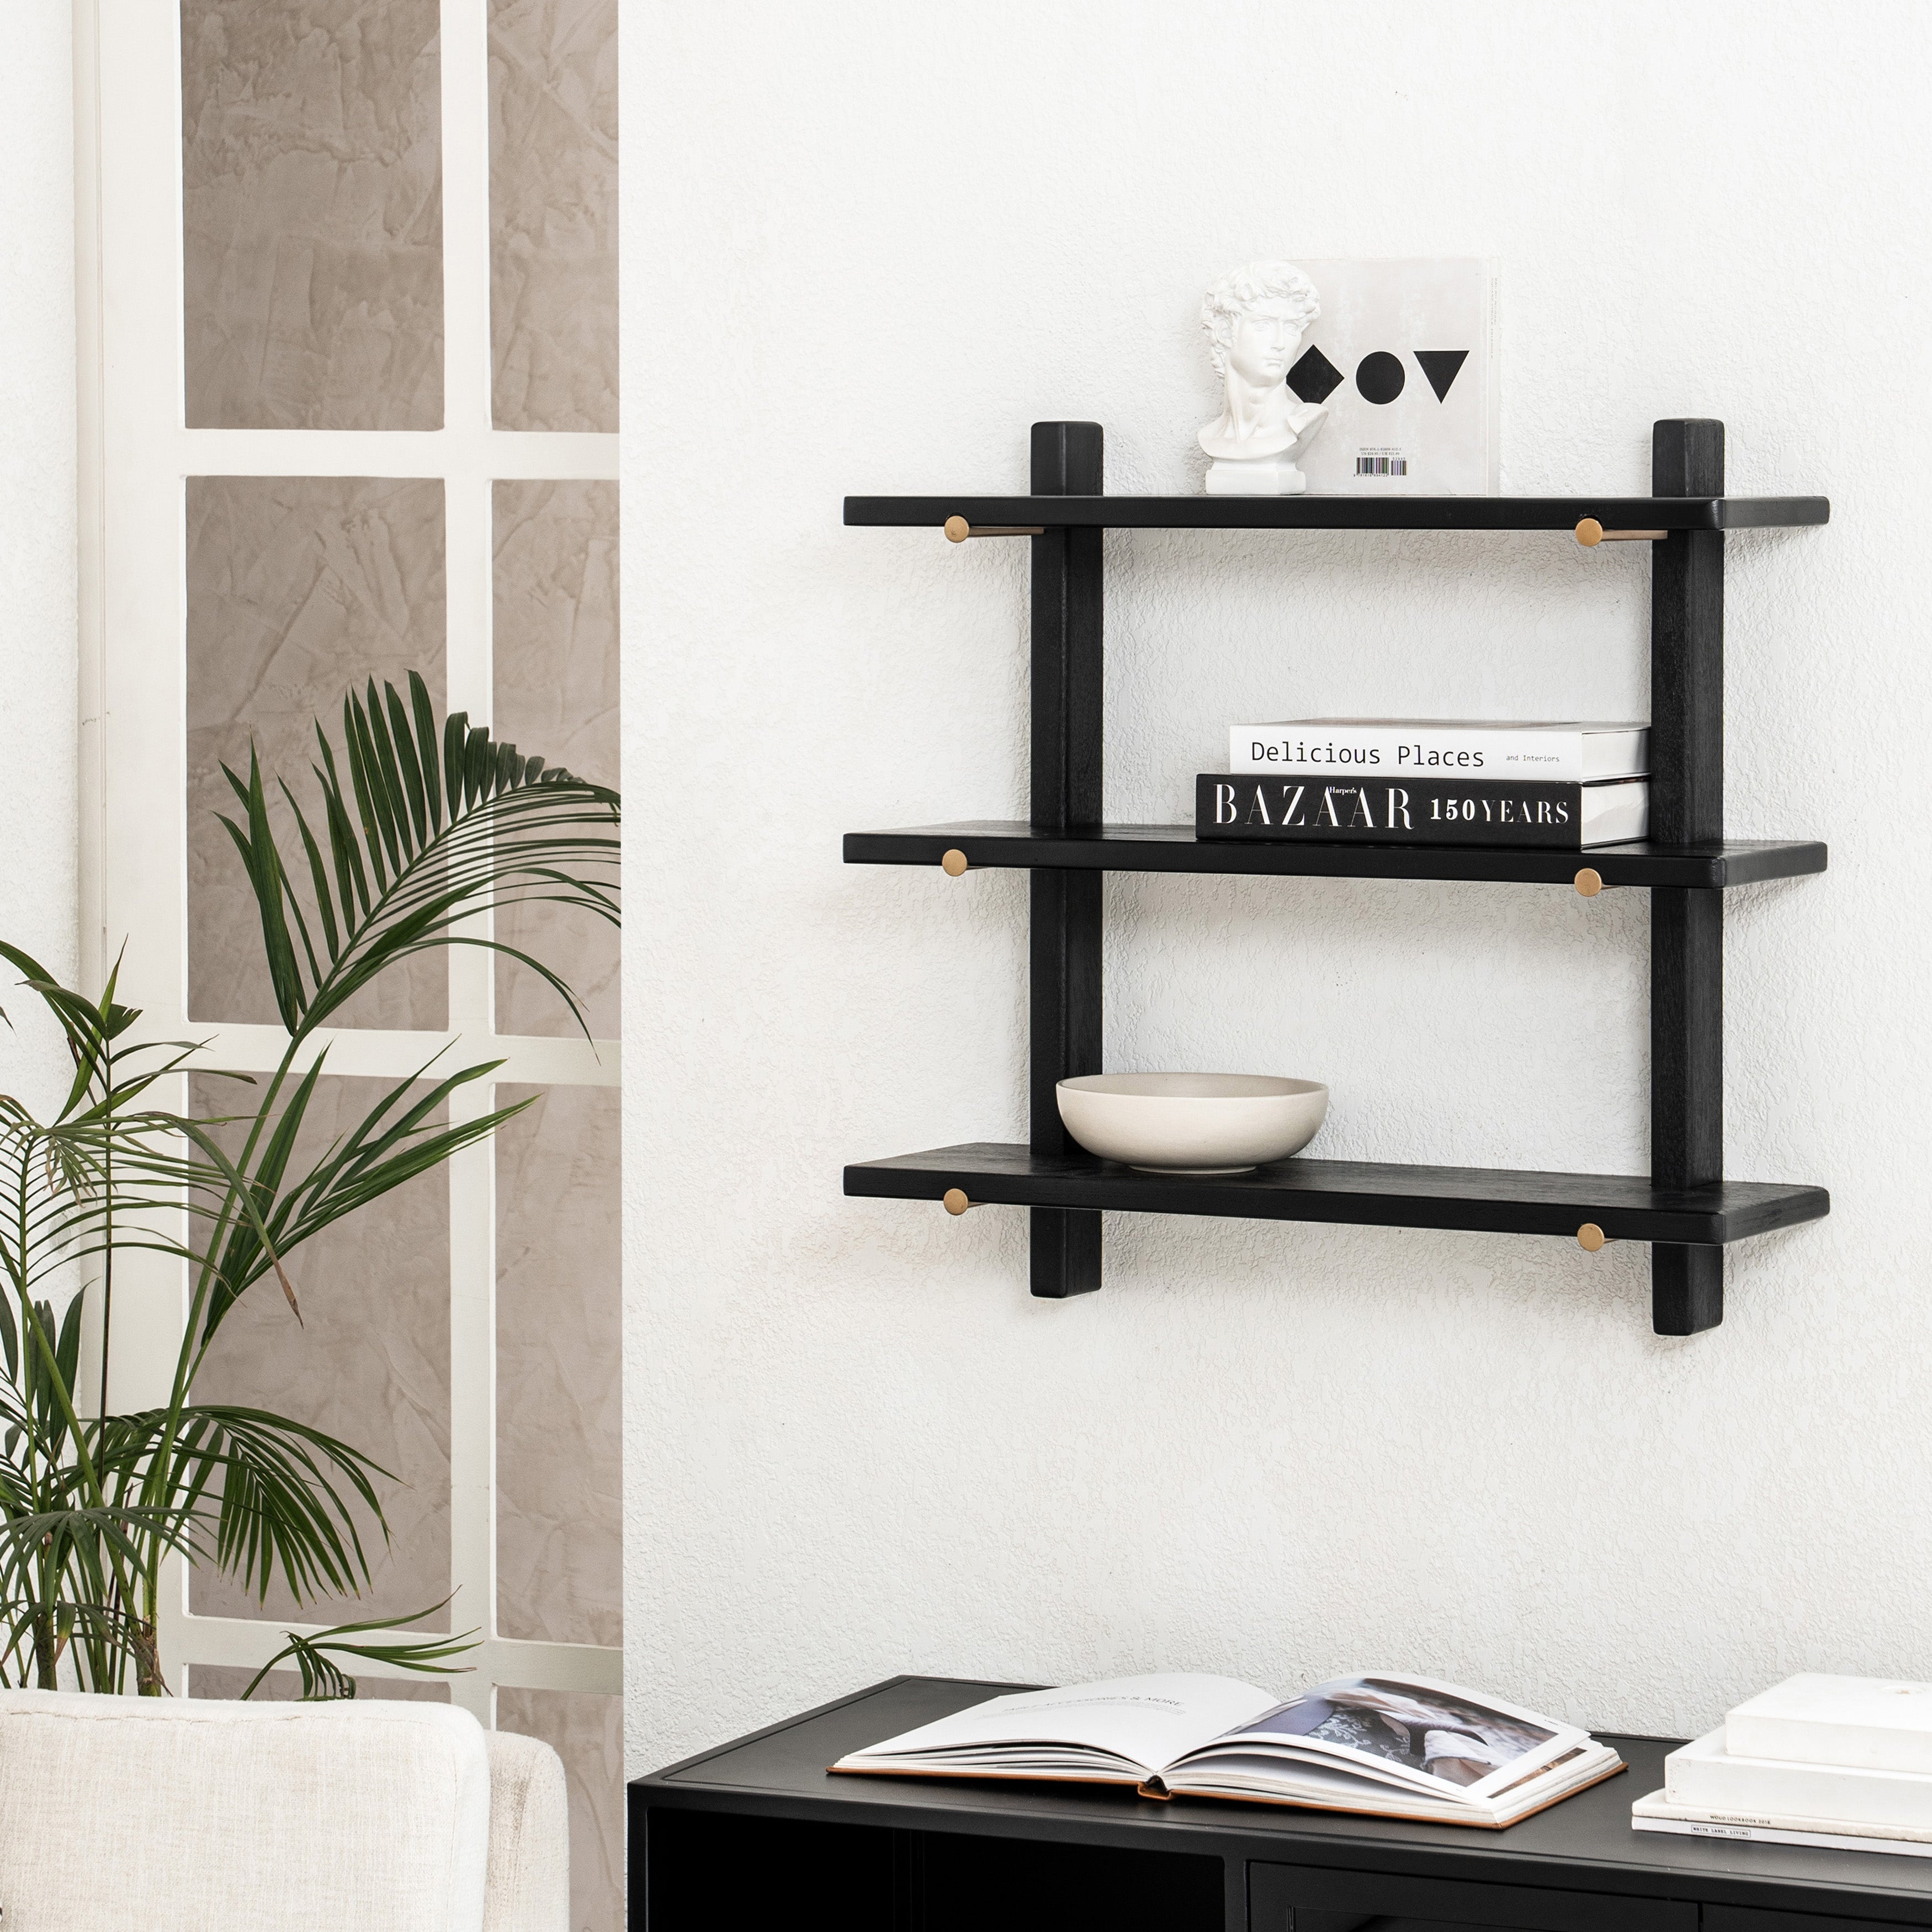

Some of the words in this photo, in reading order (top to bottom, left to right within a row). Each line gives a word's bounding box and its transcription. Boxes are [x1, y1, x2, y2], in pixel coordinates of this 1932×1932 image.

[1251, 741, 1381, 765] Delicious
[1398, 745, 1484, 767] Places
[1329, 786, 1357, 795] Harper's
[1213, 783, 1415, 830] BAZAAR
[1144, 1696, 1185, 1706] MORE
